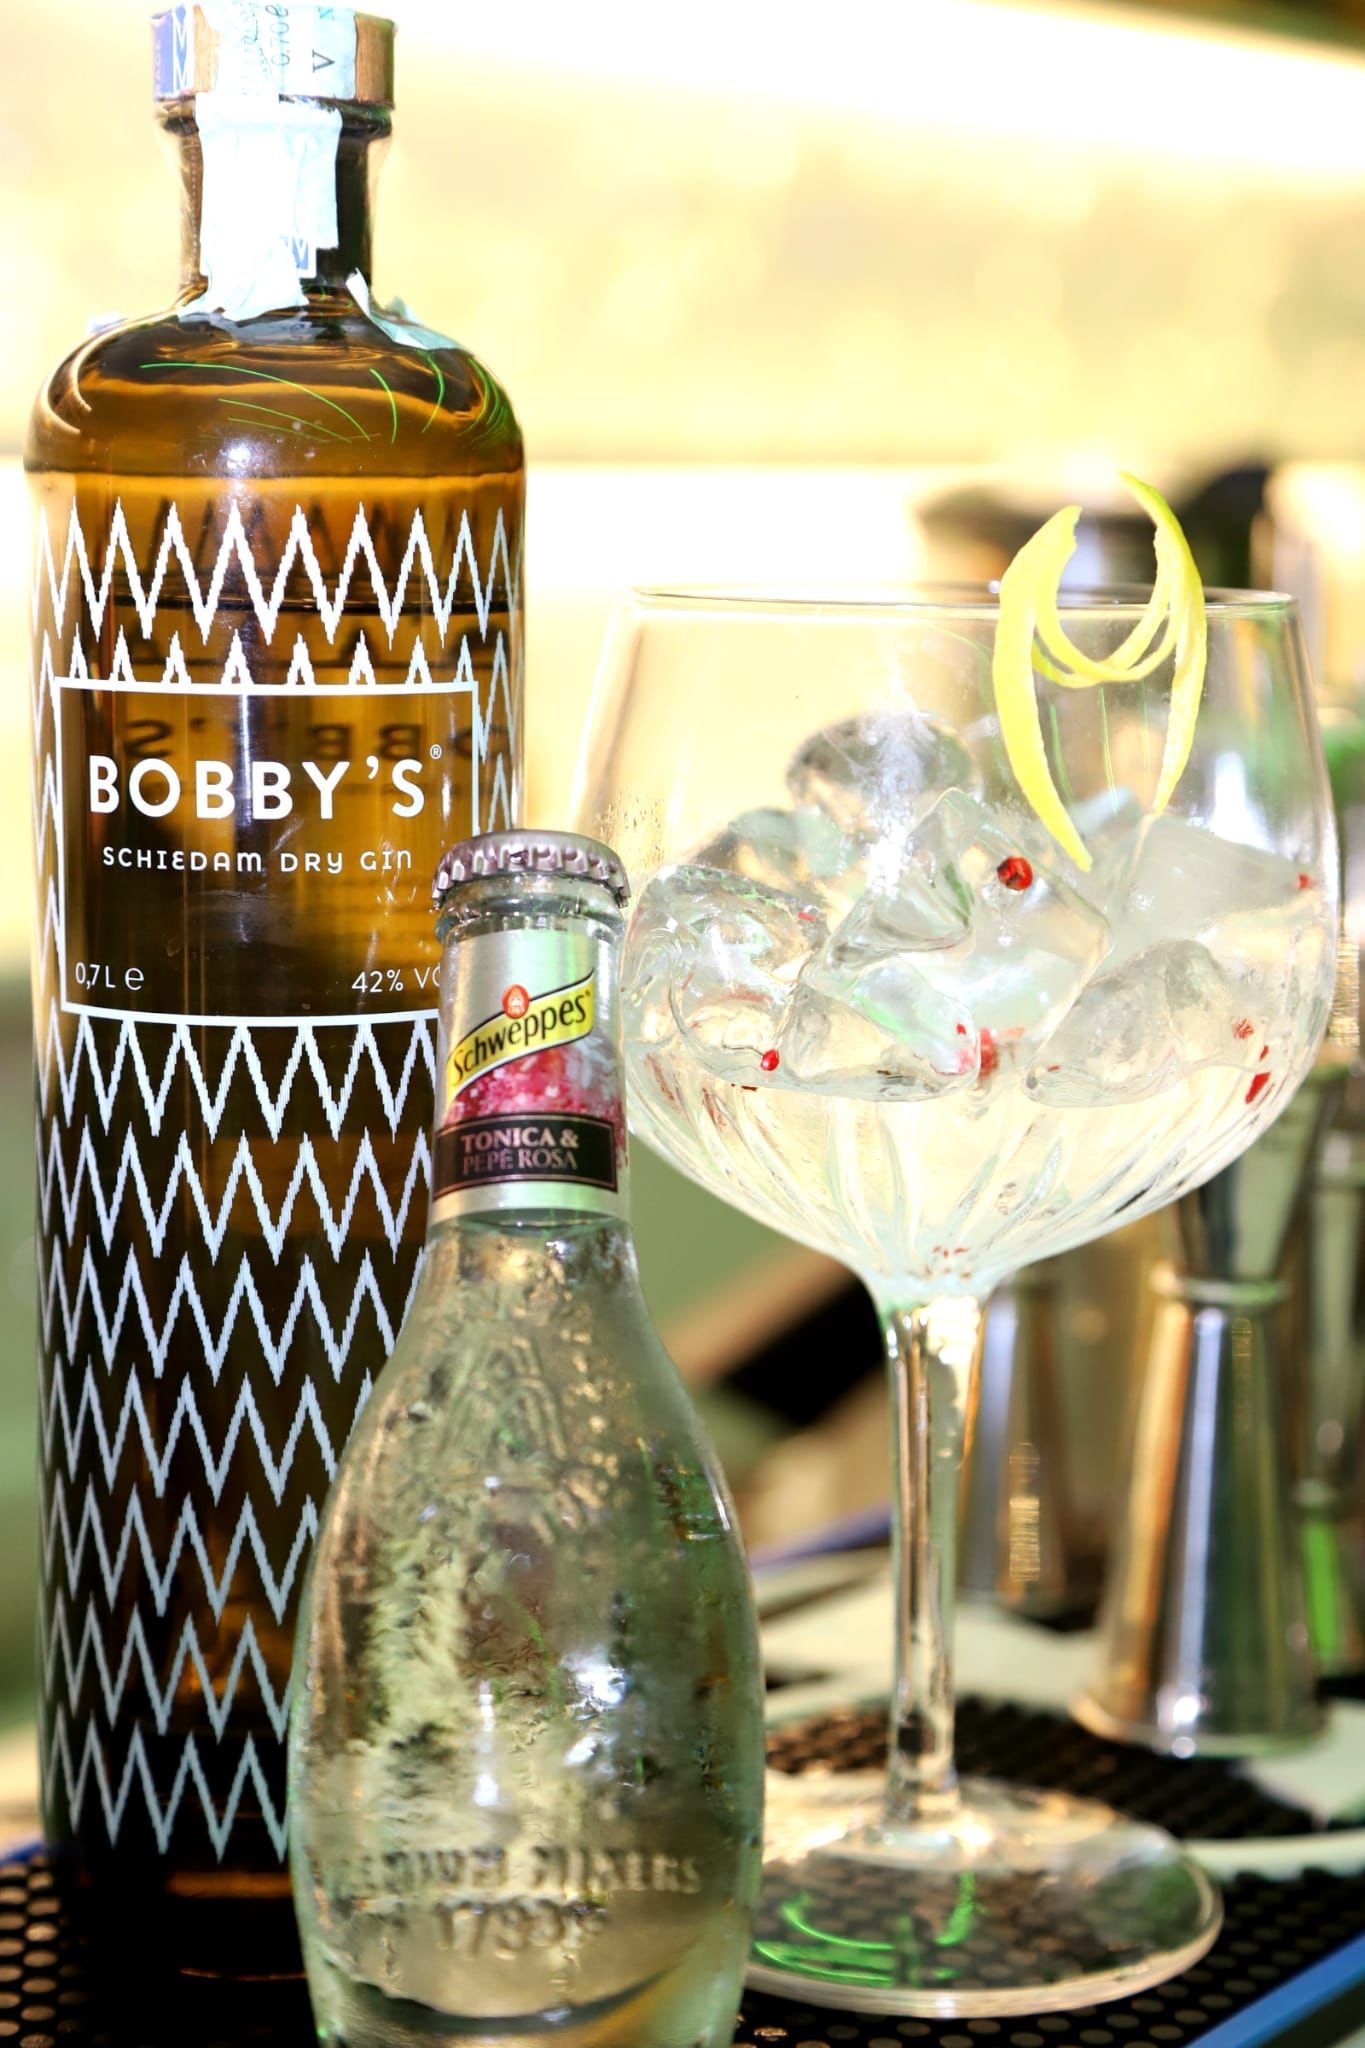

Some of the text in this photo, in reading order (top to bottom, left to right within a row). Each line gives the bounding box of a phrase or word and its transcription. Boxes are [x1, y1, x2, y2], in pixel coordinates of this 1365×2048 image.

[102, 846, 263, 873] SCHIEDAM
[280, 852, 343, 874] DRY
[351, 969, 404, 993] 42%
[453, 991, 588, 1083] Schweppes
[461, 1127, 579, 1153] TONICA &
[518, 1148, 577, 1169] ROSA
